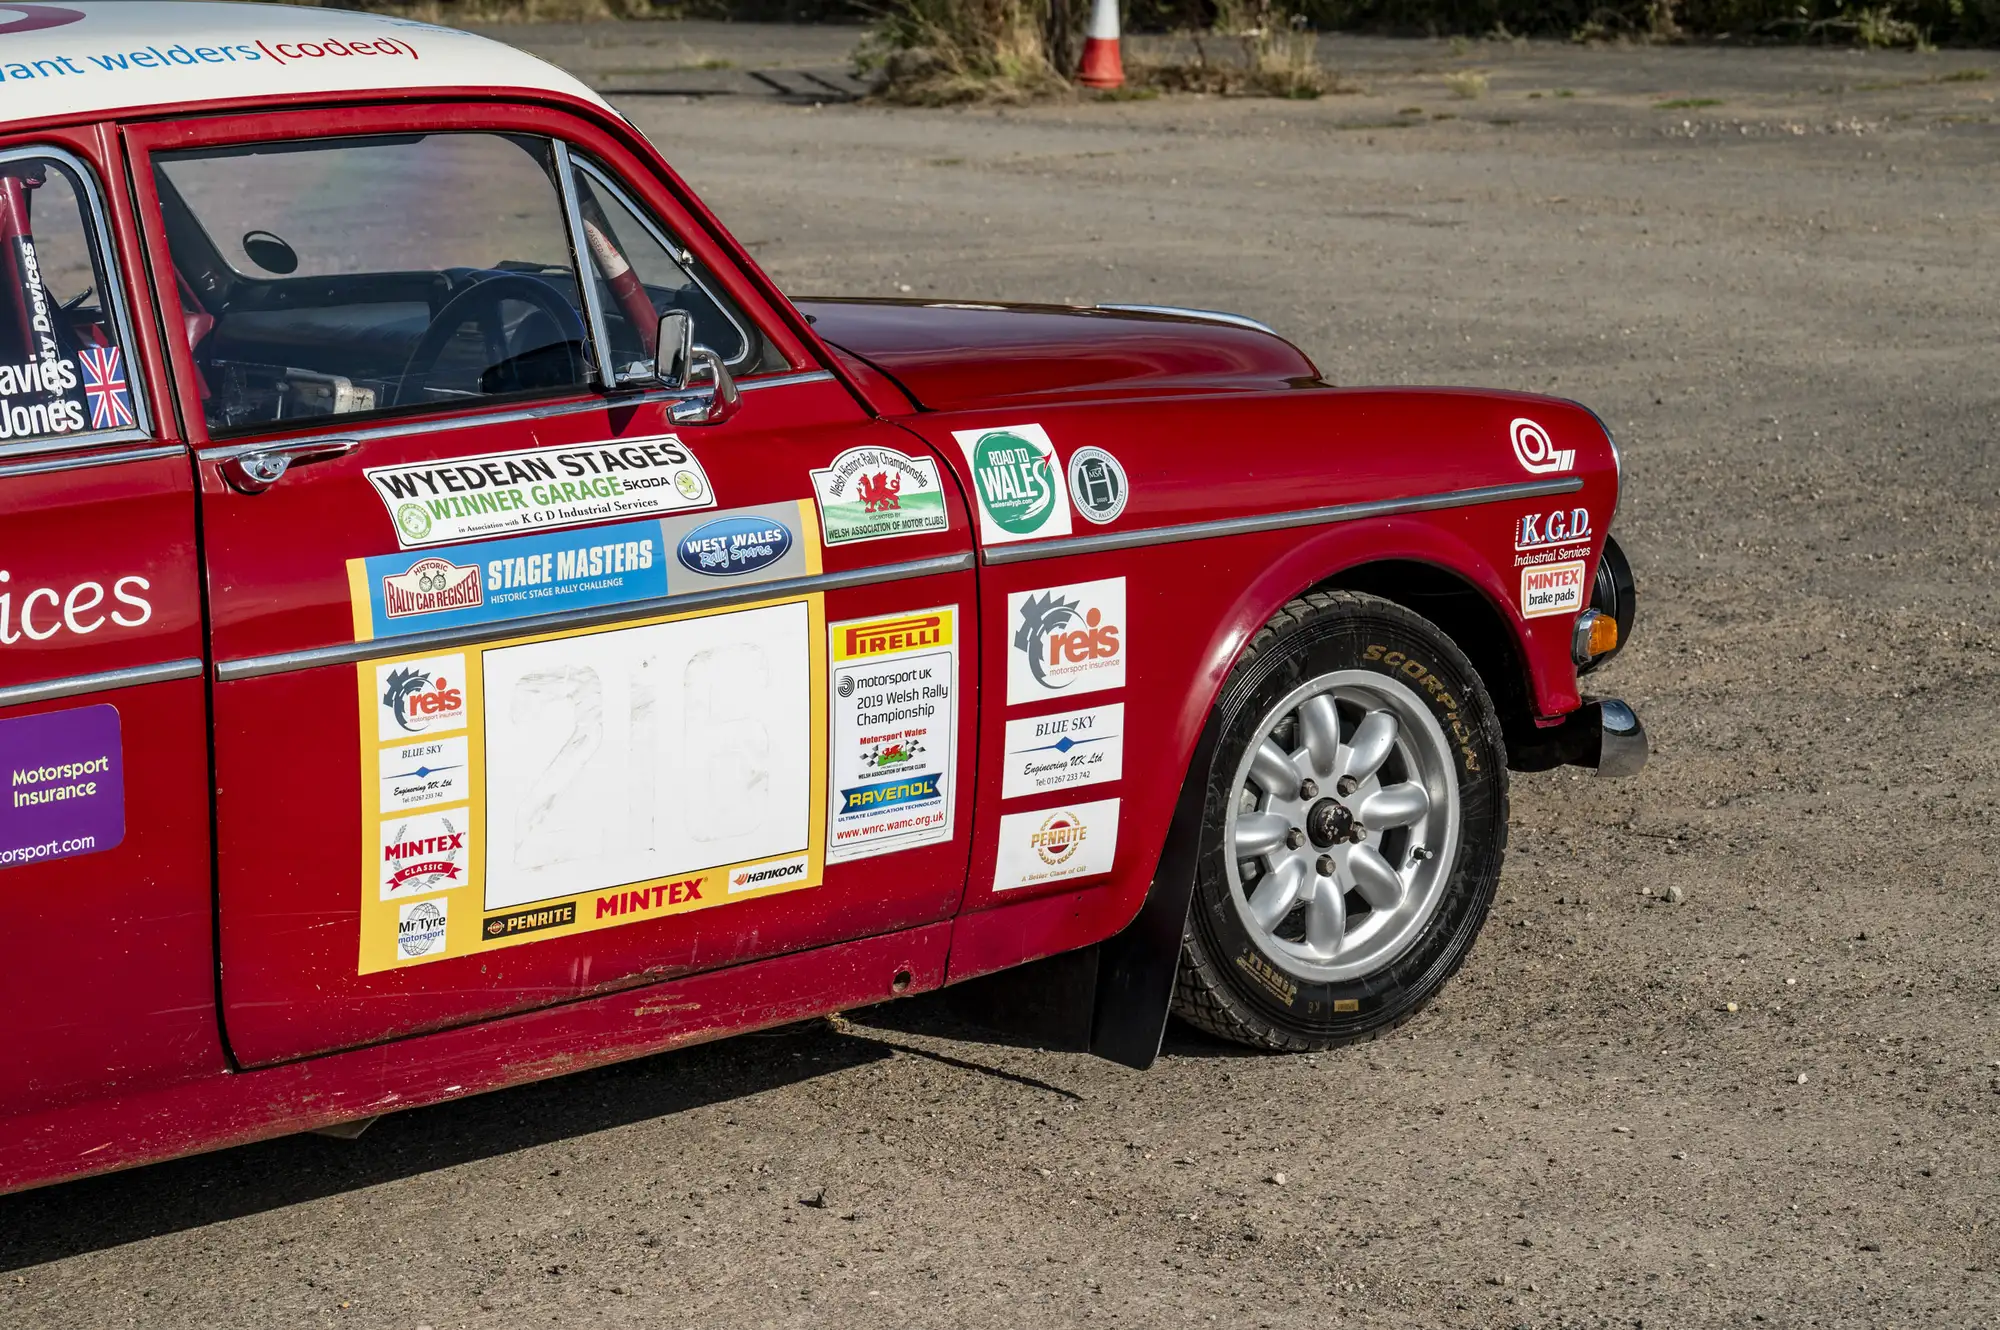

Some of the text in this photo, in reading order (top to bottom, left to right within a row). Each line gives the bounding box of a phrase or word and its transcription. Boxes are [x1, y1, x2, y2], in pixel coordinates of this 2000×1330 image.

[21, 242, 50, 332] Devices
[987, 448, 1030, 467] ROAD TO
[376, 442, 688, 499] WYEDEAN STAGES
[829, 451, 928, 498] Welsh Historic Rally Championship
[979, 461, 1050, 502] WALES
[424, 487, 529, 520] WINNER
[530, 475, 625, 507] GARAGE
[623, 477, 671, 491] ŠKODA
[467, 522, 504, 533] Association
[504, 519, 519, 527] with
[521, 513, 531, 524] K
[533, 512, 543, 522] G
[547, 510, 556, 521] D
[558, 502, 612, 519] Industrial
[613, 498, 659, 511] Services
[828, 515, 944, 540] WELSH ASSOCIATION OF MOTOR CLUBS
[1519, 507, 1593, 546] K.G.D.
[687, 529, 782, 554] WEST WALES
[488, 539, 653, 591] STAGE MASTERS
[699, 545, 773, 568] Rally Spares
[1514, 545, 1591, 567] Industrial Services
[413, 562, 449, 576] HISTORIC
[1527, 568, 1580, 591] MINTEX
[387, 569, 480, 614] RALLY CAR REGISTER
[490, 577, 624, 604] HISTORIC STAGE RALLY CHALLENGE
[1528, 589, 1575, 606] brake pads
[846, 616, 940, 656] PIRELLI
[1049, 607, 1120, 666] reis
[857, 668, 932, 689] motorsport UK
[1049, 658, 1120, 676] motorsport insurance
[409, 677, 462, 717] reis
[857, 684, 949, 710] 2019 Welsh Rally
[409, 713, 438, 723] motorsport
[857, 703, 935, 726] Championship
[1035, 714, 1096, 737] BLUE SKY
[859, 728, 927, 745] Motorsport Wales
[401, 744, 443, 759] BLUE SKY
[12, 756, 109, 787] Motorsport
[1023, 752, 1104, 776] Engineering UK Ltd
[393, 778, 452, 796] Engineering UK Ltd
[1046, 773, 1066, 785] 01267
[1066, 772, 1078, 782] 233
[1079, 770, 1091, 780] 742
[13, 780, 97, 808] Insurance
[838, 799, 942, 823] ULTIMATE LUBRICATION TECHNOLOGY
[836, 811, 944, 840] www.wnrc.wamc.org.uk
[1031, 825, 1087, 848] PENRITE
[384, 832, 464, 862] MINTEX
[404, 863, 443, 876] CLASSIC
[398, 915, 446, 934] Mr Tyre
[506, 907, 572, 932] PENRITE
[398, 928, 444, 944] motorsport
